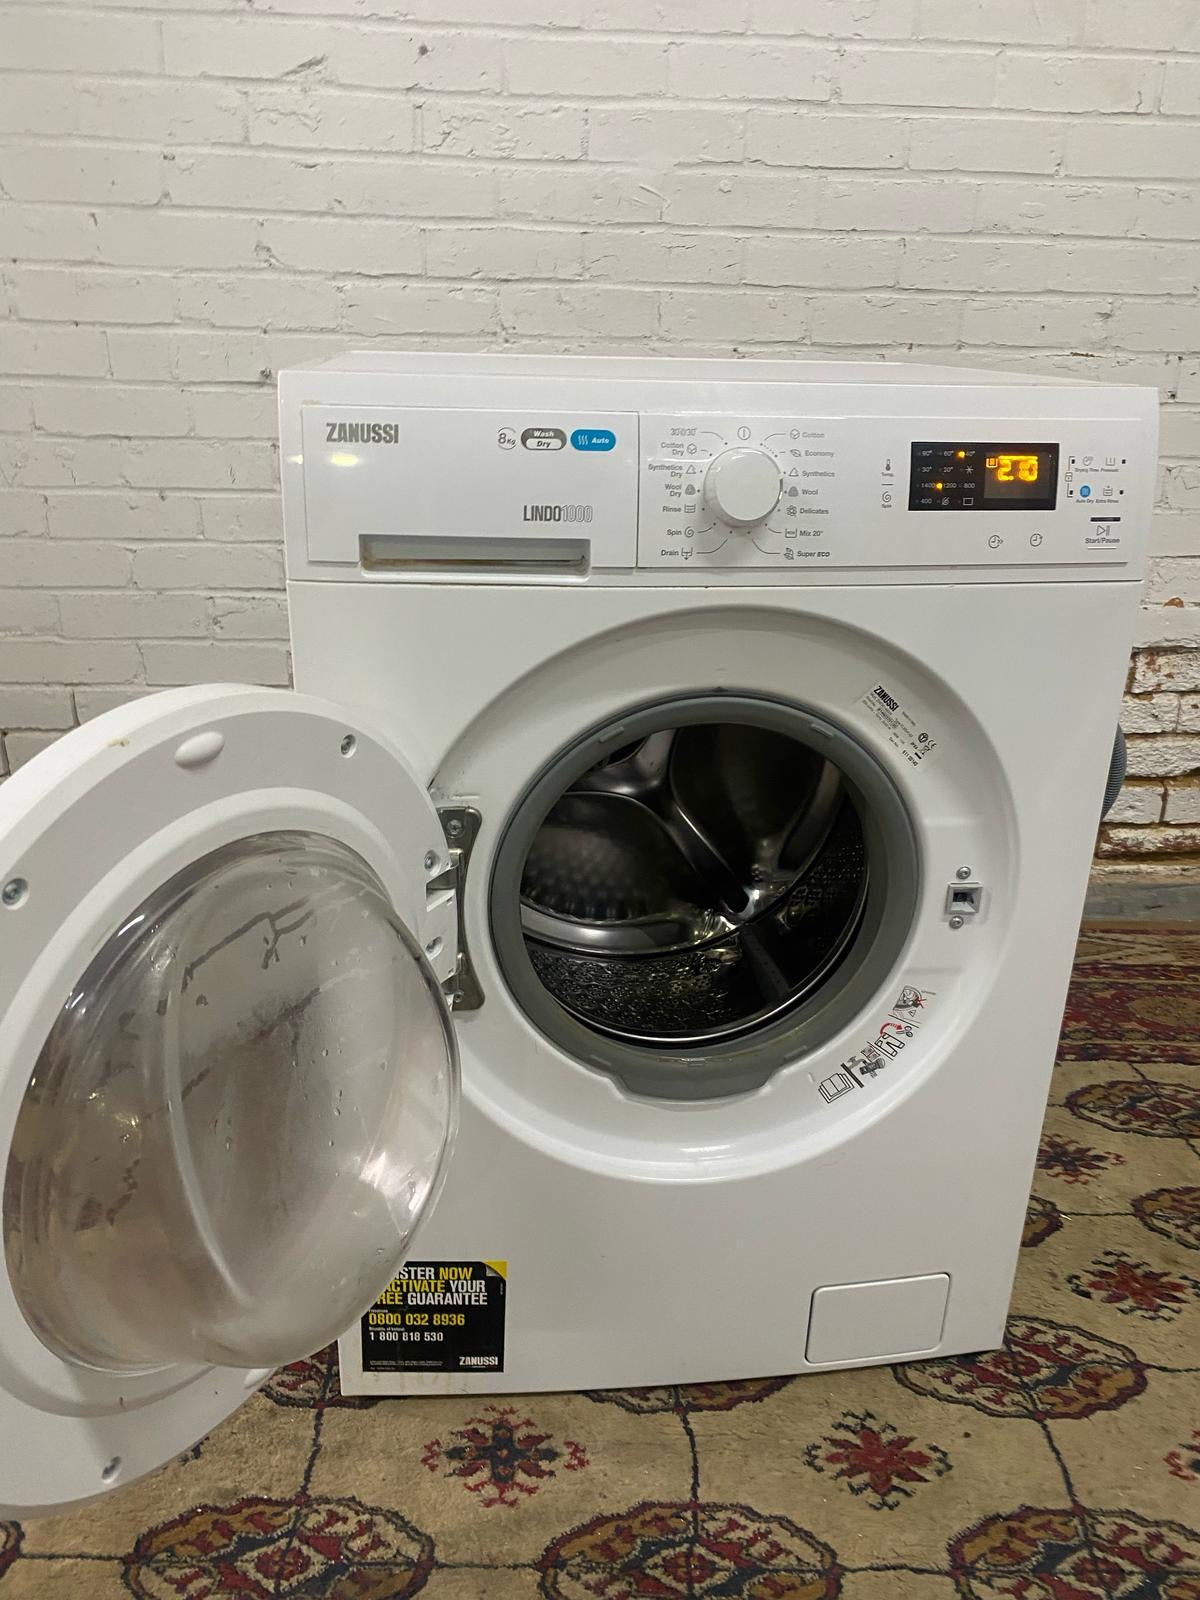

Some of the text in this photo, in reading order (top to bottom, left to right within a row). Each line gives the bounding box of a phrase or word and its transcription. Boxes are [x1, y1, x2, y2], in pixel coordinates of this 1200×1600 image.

[326, 422, 399, 444] ZANUSSI
[533, 430, 555, 438] Wash
[536, 440, 552, 449] Dry
[591, 436, 610, 445] Auto
[671, 448, 685, 457] Dry
[804, 449, 834, 458] Economy
[647, 463, 683, 472] Synthetics
[670, 470, 683, 479] Dry
[802, 470, 836, 478] Synthetics
[664, 483, 682, 491] Wool
[669, 490, 682, 498] Dry
[801, 488, 819, 496] Wool
[662, 505, 682, 513] Rinse
[799, 507, 830, 515] Delicates
[666, 528, 683, 537] Spin
[799, 529, 811, 537] Mix
[660, 549, 680, 557] Drain
[797, 550, 817, 559] Super
[873, 685, 900, 712] ZANUSSI
[439, 1267, 473, 1280] NOW
[449, 1280, 486, 1293] YOUR
[407, 1292, 488, 1306] GUARANTEE
[368, 1312, 465, 1326] 0800 032 8936
[369, 1332, 375, 1341] 1
[379, 1332, 399, 1341] 800
[424, 1332, 444, 1342] 530
[459, 1355, 499, 1367] ZANUSSI
